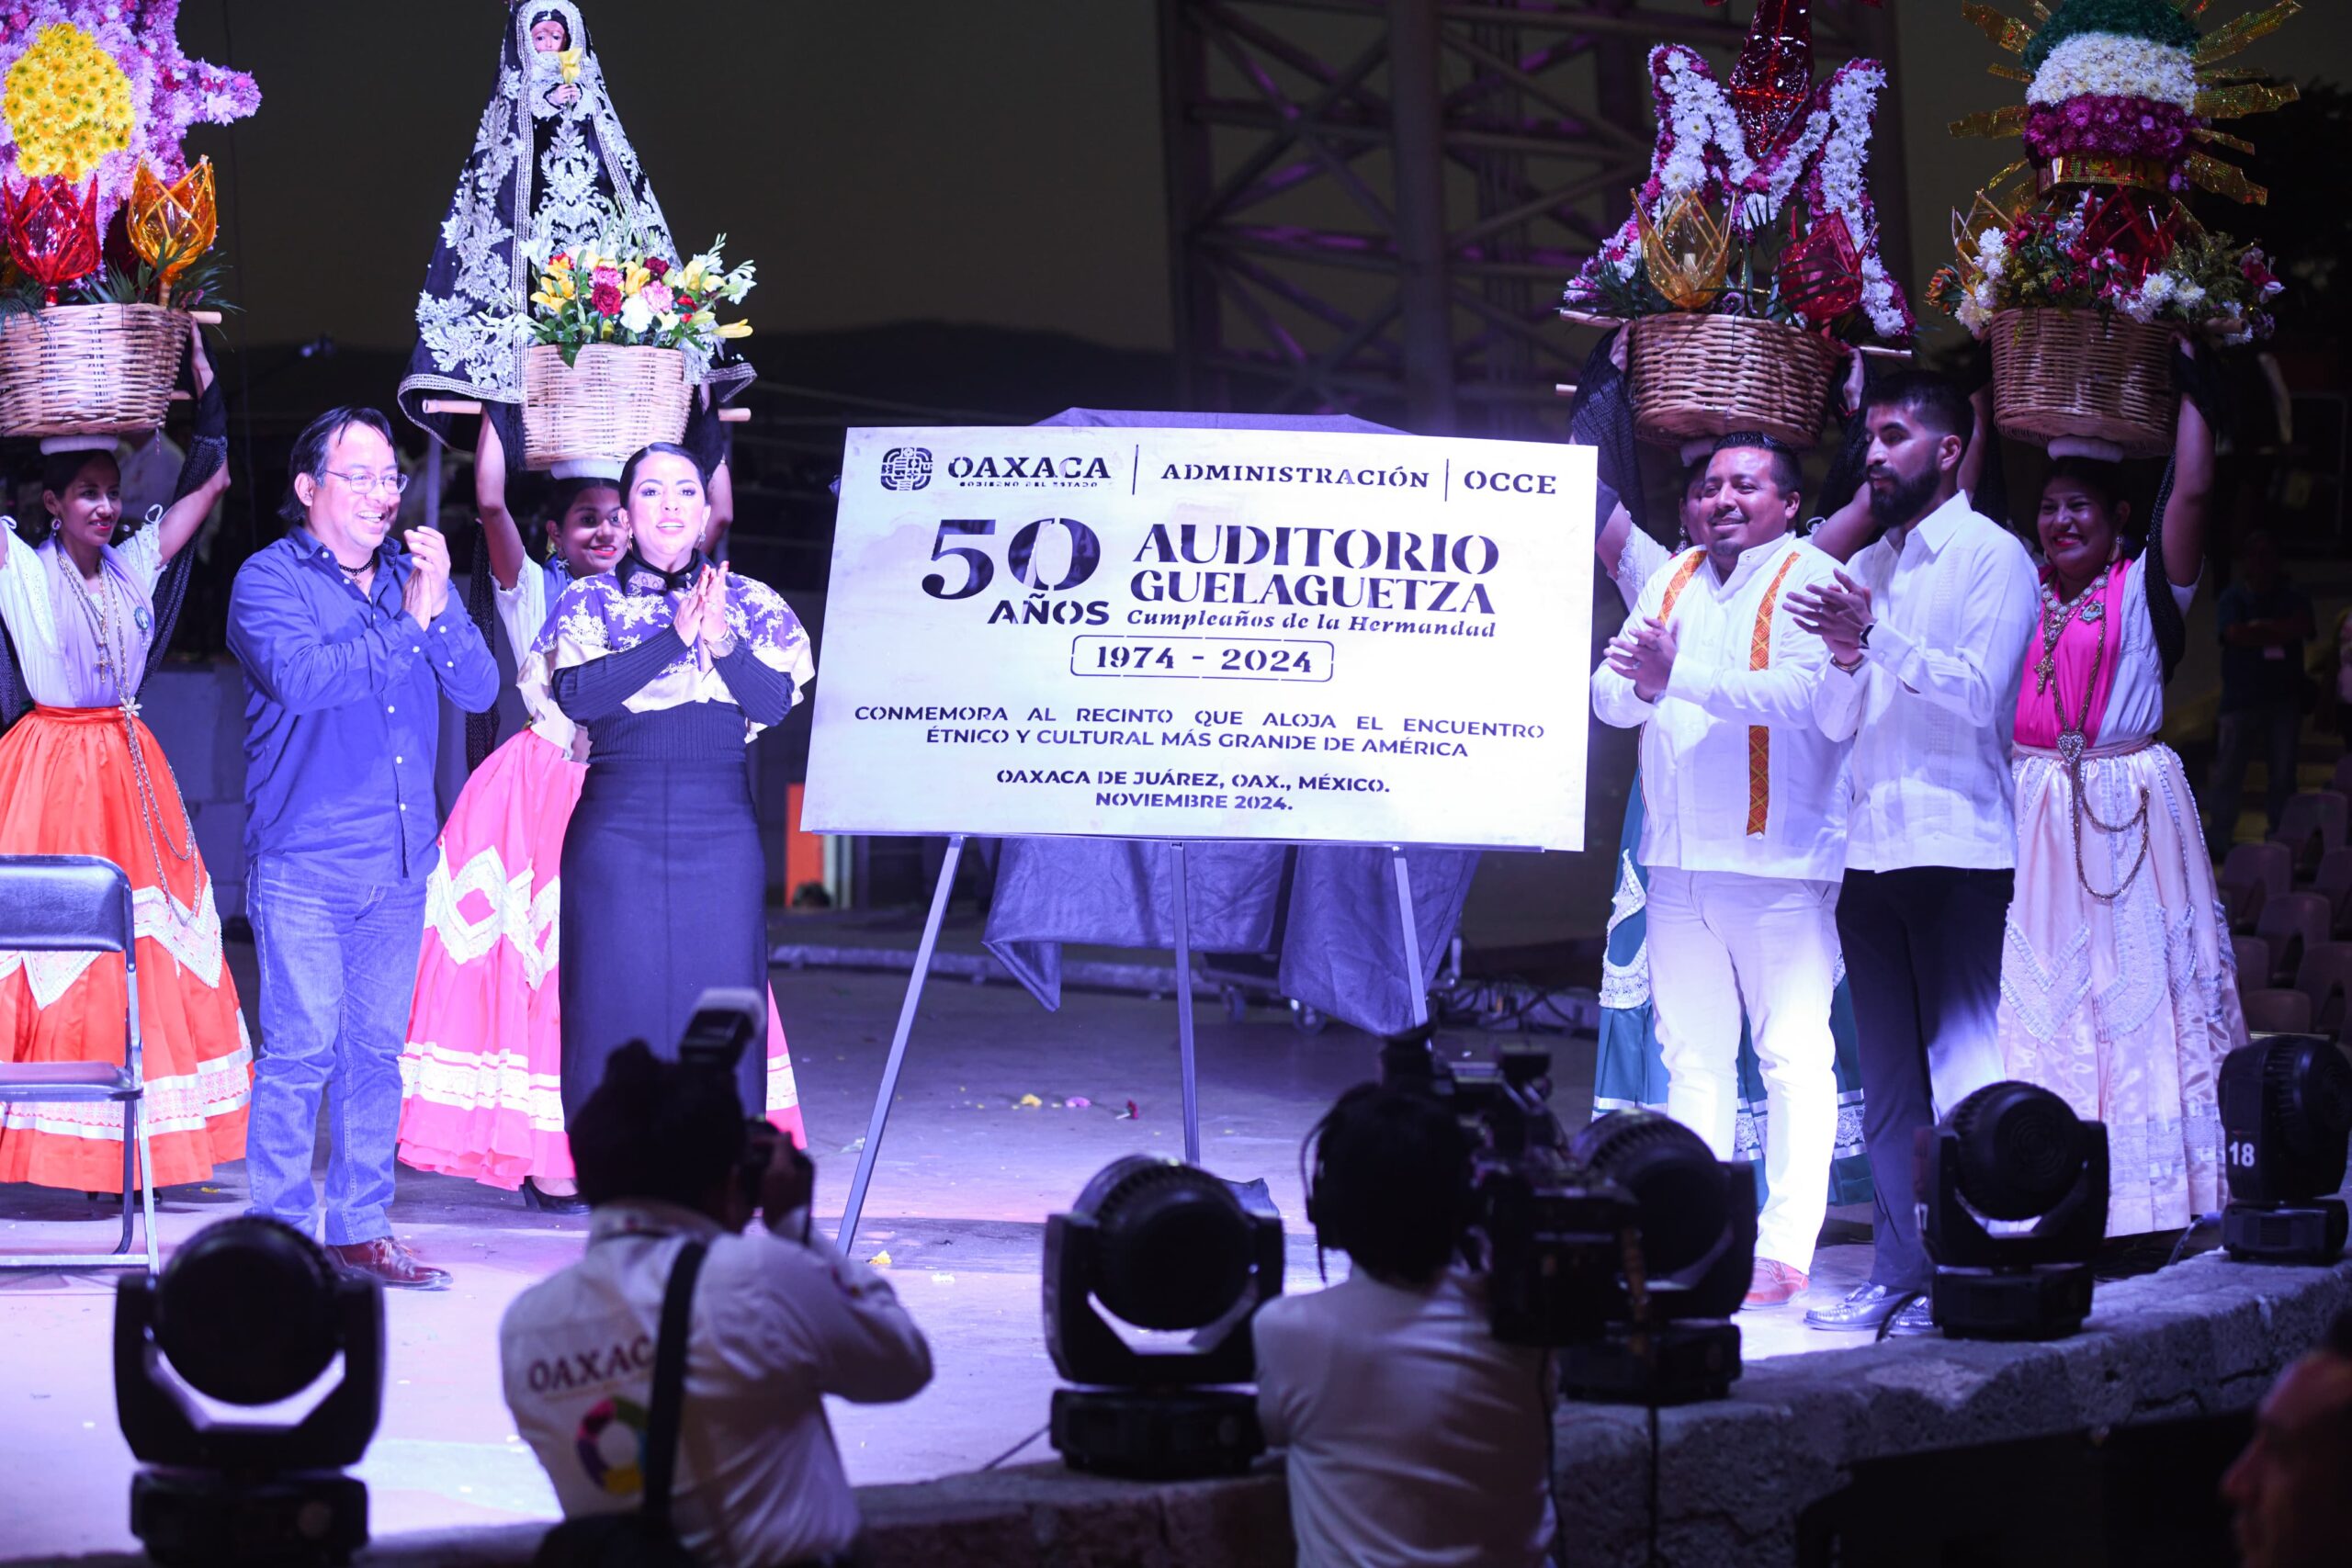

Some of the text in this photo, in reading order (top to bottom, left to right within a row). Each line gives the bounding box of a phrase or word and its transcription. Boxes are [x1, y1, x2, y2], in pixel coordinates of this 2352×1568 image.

[948, 457, 1111, 479] OAXACA
[1161, 464, 1429, 489] ADMINISTRACIÓN
[1464, 469, 1556, 495] OCCE
[922, 517, 1102, 600] 50
[1132, 523, 1499, 576] AUDITORIO
[1130, 570, 1496, 615] GUELAGUETZA
[988, 592, 1110, 626] AÑOS
[1126, 609, 1496, 638] Cumpleaños de la Hermandad
[1096, 646, 1175, 670] 1974
[1220, 649, 1312, 673] 2024
[854, 705, 1544, 739] CONMEMORA AL RECINTO QUE ALOJA EL ENCUENTRO
[926, 726, 1468, 758] ÉTNICO Y CULTURAL MÁS GRANDE DE AMÉRICA
[996, 768, 1390, 793] OAXACA DE JUÁREZ, OAX., MÉXICO.
[1095, 792, 1294, 811] NOVIEMBRE 2024.
[2229, 1141, 2256, 1168] 18
[528, 1334, 656, 1393] OAXAC
